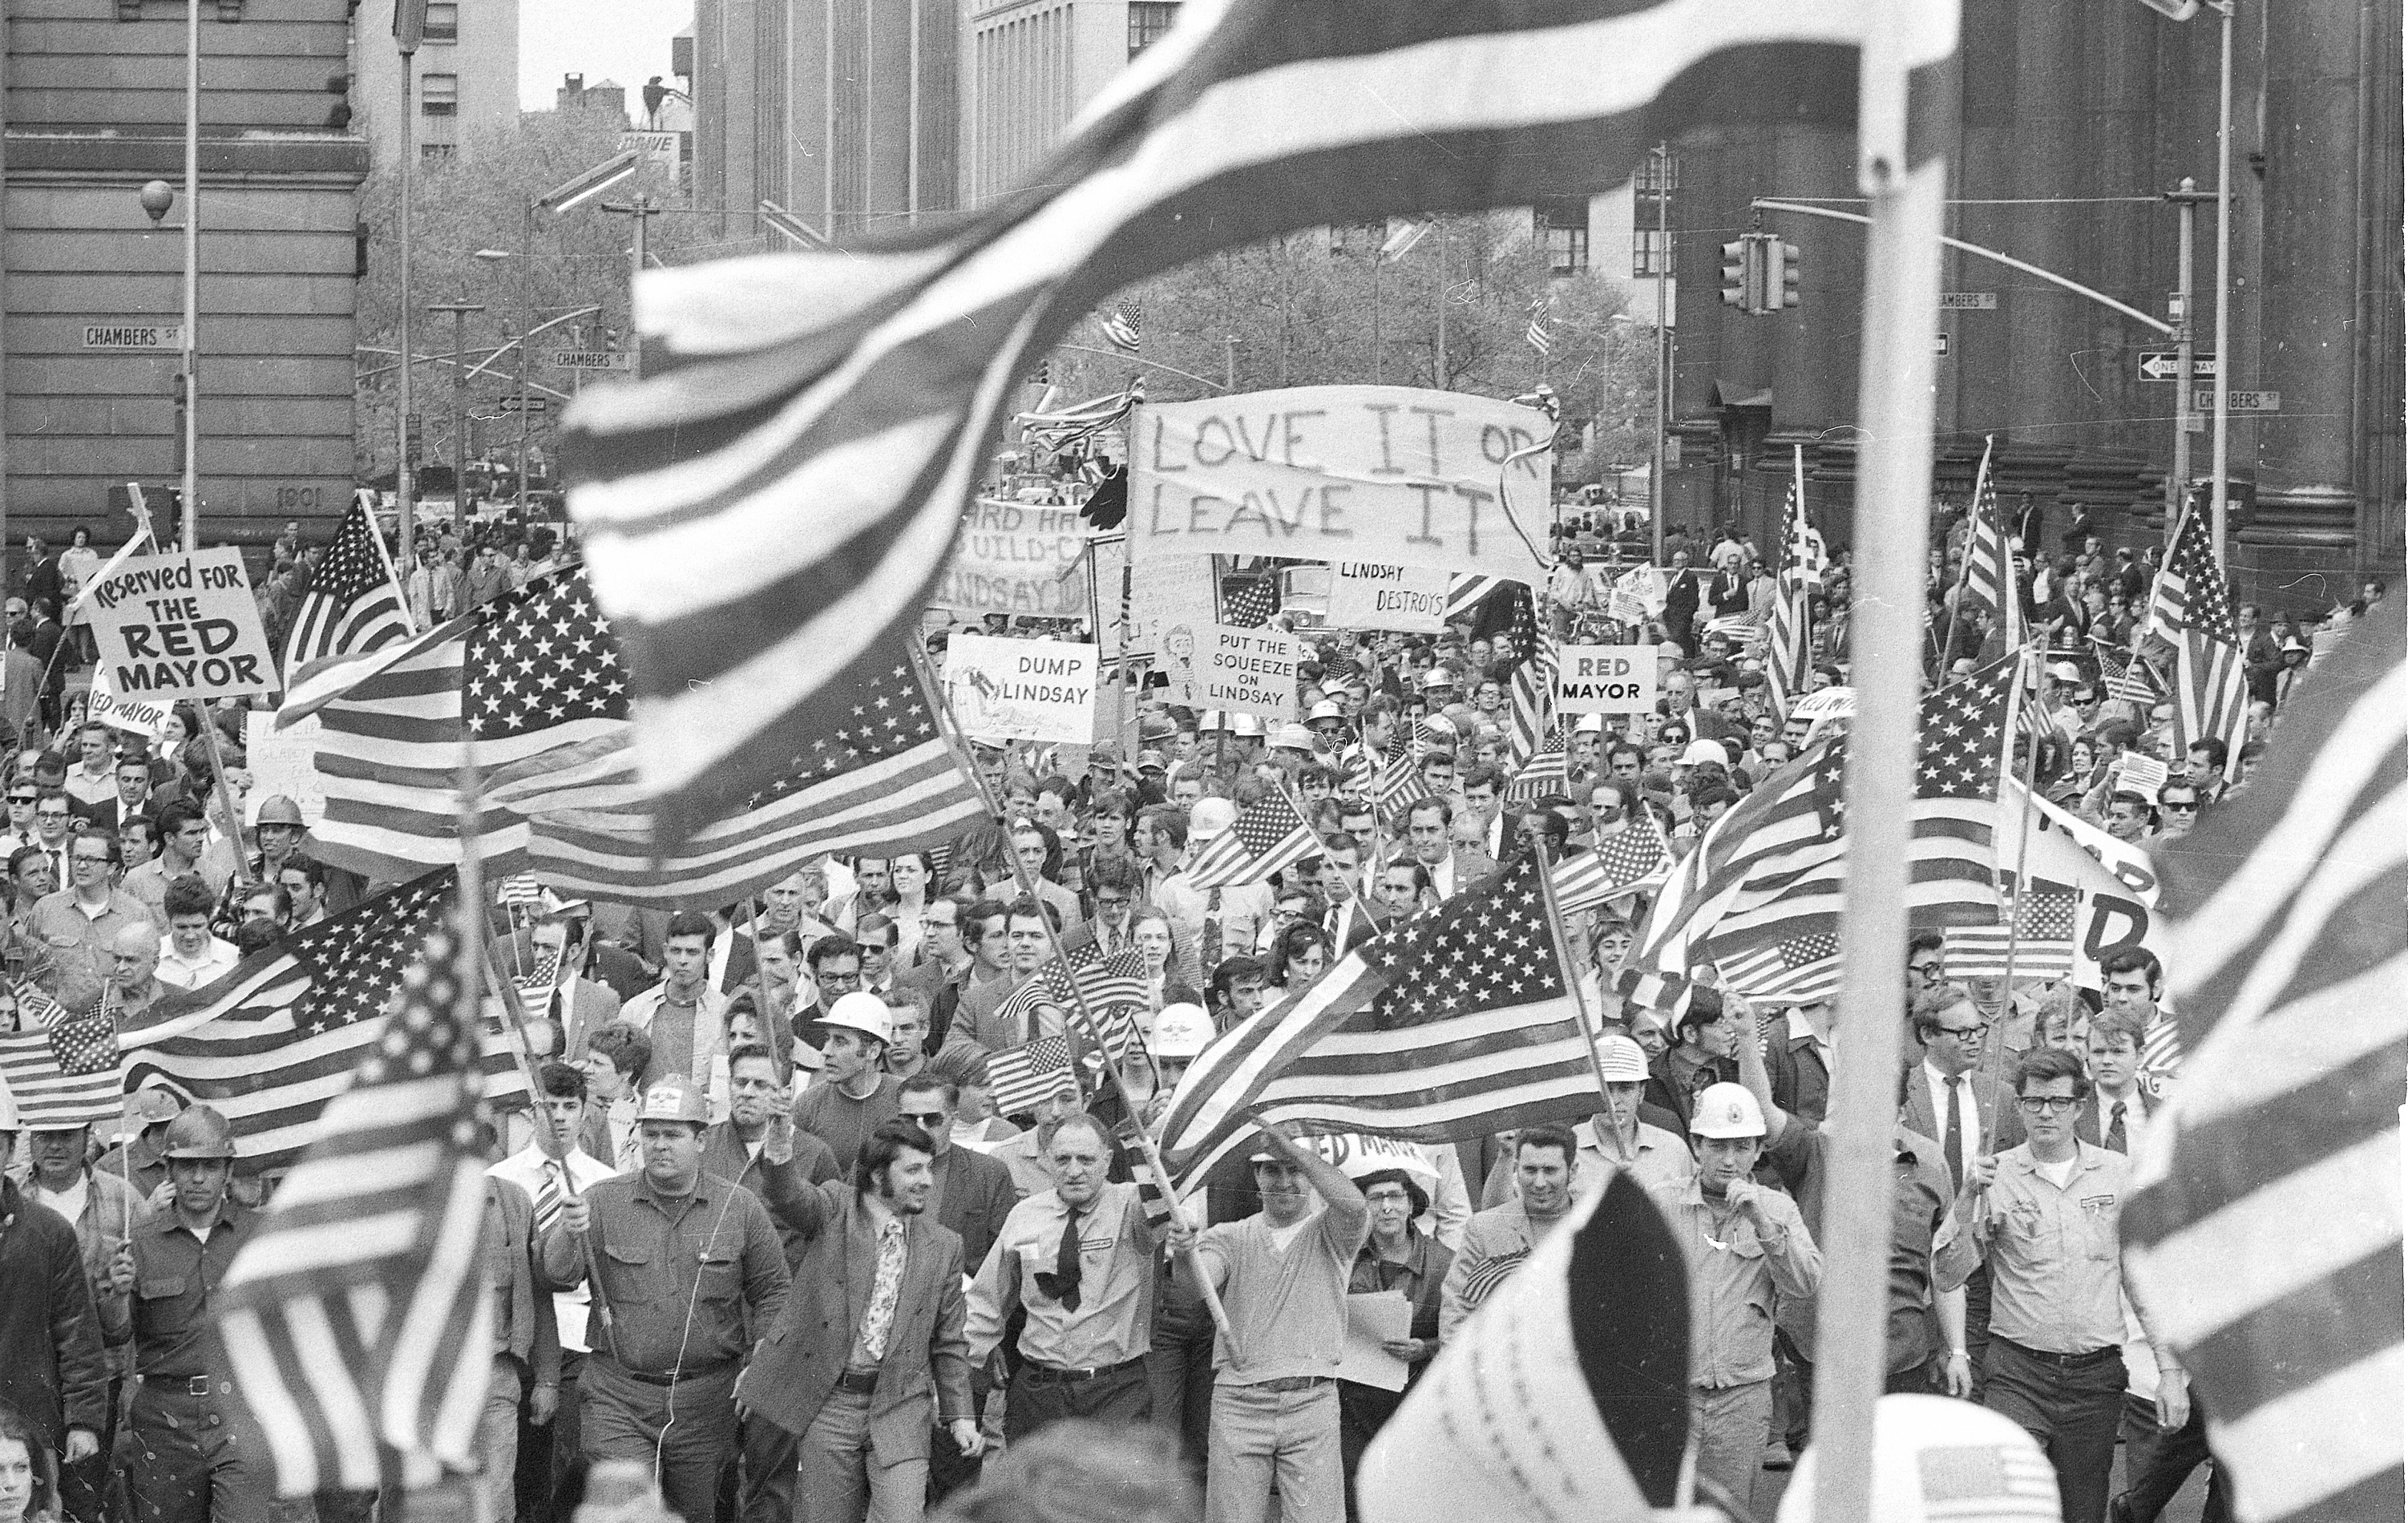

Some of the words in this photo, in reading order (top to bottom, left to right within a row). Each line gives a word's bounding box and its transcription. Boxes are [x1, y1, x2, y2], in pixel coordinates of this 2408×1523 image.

[86, 328, 157, 345] CHAMBERS
[557, 353, 610, 367] CHAMBERS
[2153, 362, 2176, 372] ONE
[2199, 393, 2261, 409] CHBERS
[1152, 410, 1327, 473] LOVE
[1364, 403, 1456, 475] IT
[1149, 483, 1353, 537] LEAVE
[1406, 482, 1494, 556] IT
[199, 564, 244, 589] FOR
[1341, 561, 1404, 581] LINDSAY
[146, 596, 200, 622] THE
[1376, 590, 1443, 616] DESTROYS
[119, 618, 238, 659] RED
[1220, 634, 1250, 650] PUT
[1257, 639, 1287, 656] THE
[117, 653, 264, 693] MAYOR
[1019, 656, 1081, 676] DUMP
[1213, 652, 1293, 677] SQUEEZE
[1578, 657, 1630, 677] RED
[1238, 674, 1258, 686] ON
[1563, 683, 1640, 699] MAYOR
[1004, 683, 1089, 705] LINDSAY
[1210, 684, 1284, 706] LINDSAY
[112, 702, 164, 729] MAYOR
